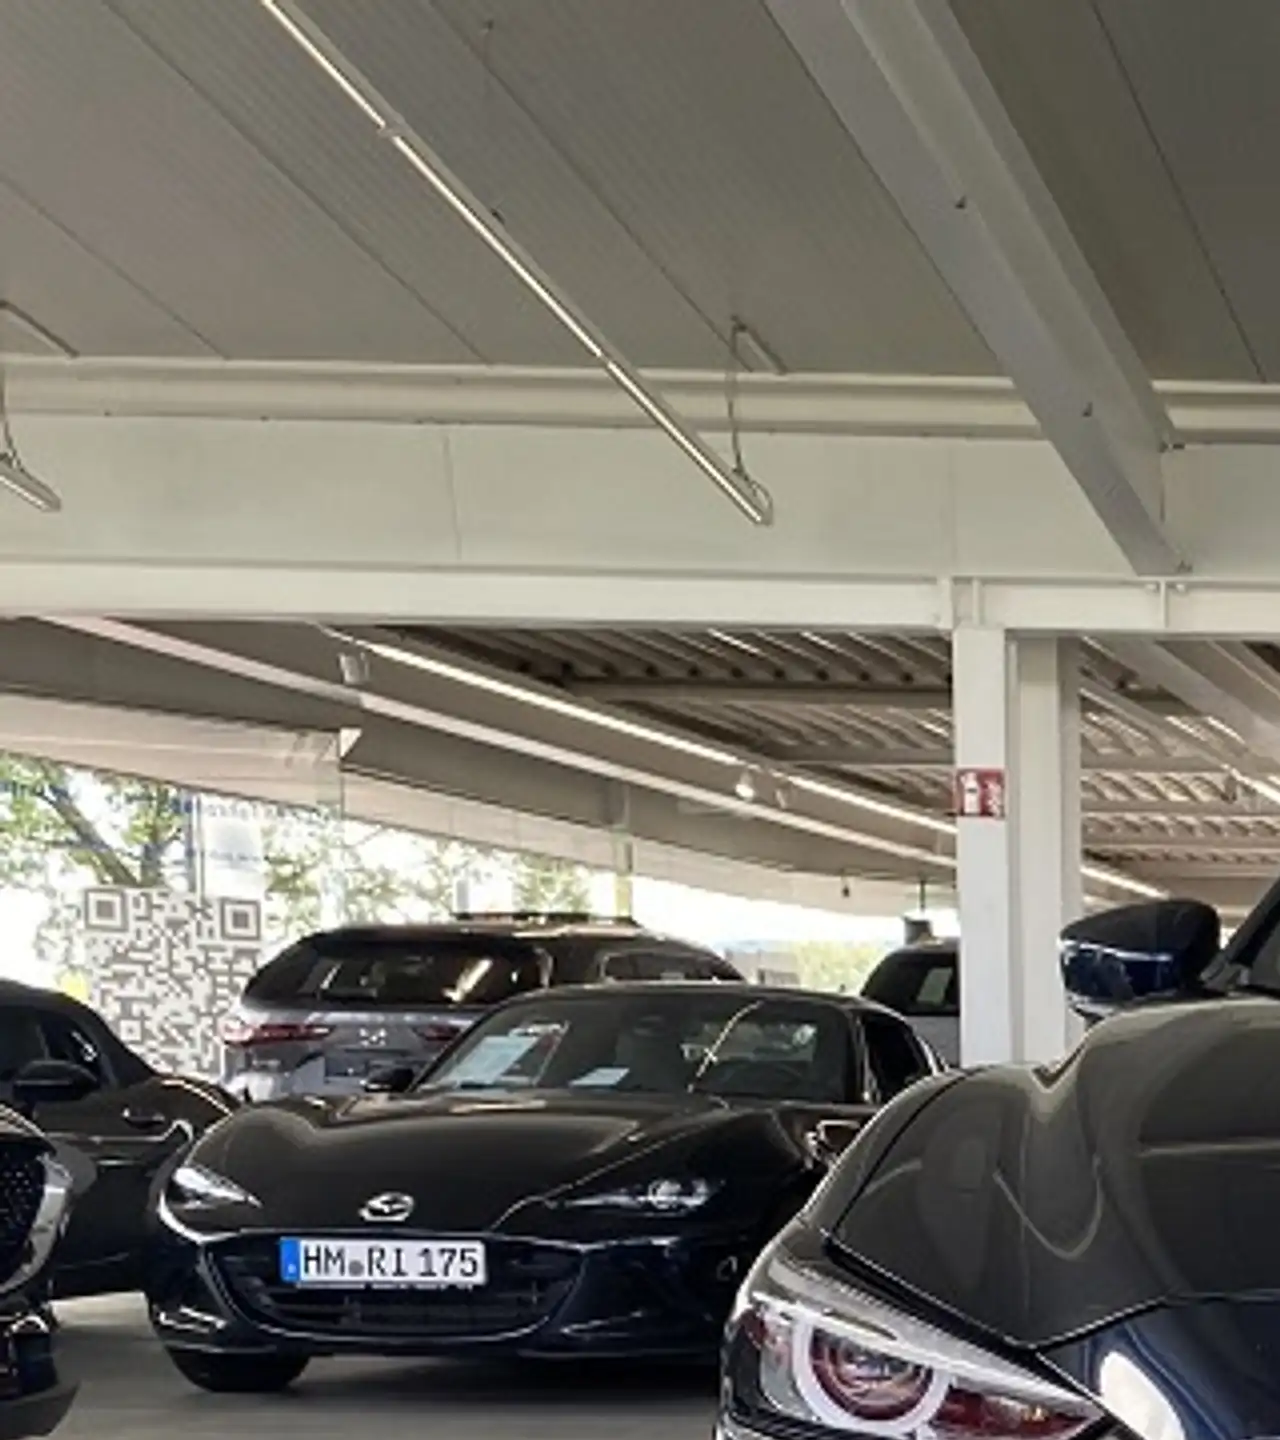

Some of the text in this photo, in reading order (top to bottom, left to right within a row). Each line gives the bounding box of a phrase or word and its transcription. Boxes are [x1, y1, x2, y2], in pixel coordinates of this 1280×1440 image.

[304, 1246, 478, 1277] HM RI 175
